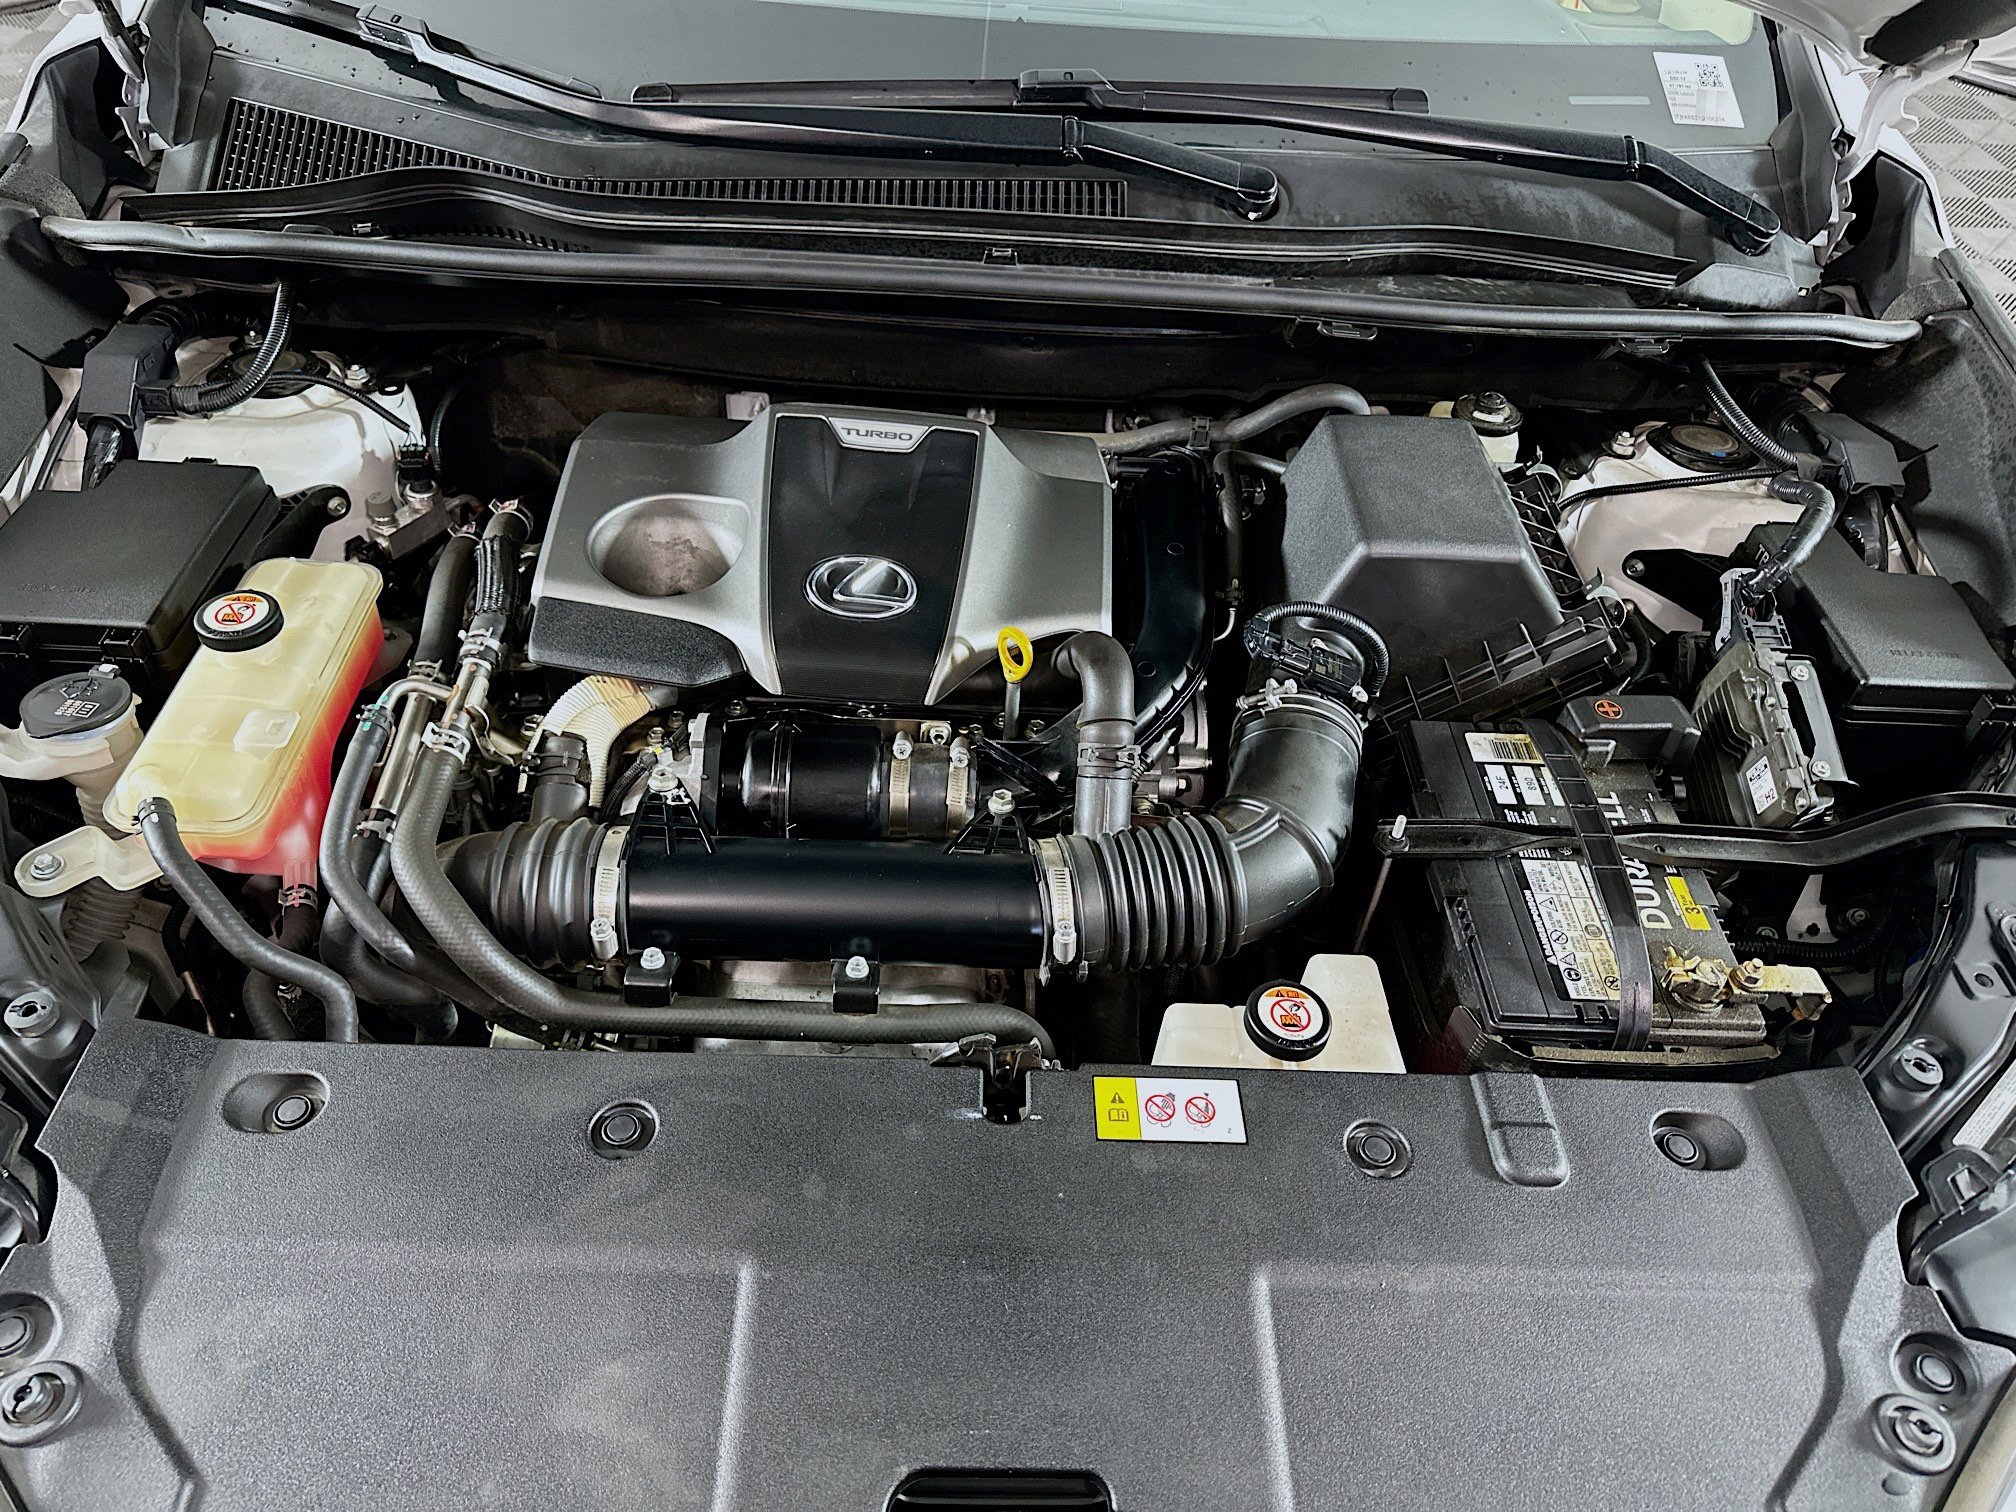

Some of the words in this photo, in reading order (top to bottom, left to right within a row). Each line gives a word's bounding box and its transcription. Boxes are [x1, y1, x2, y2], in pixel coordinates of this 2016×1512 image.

[841, 427, 914, 442] TURBO
[1495, 775, 1509, 791] 24F
[1764, 787, 1776, 804] H2
[1685, 906, 1701, 915] 3
